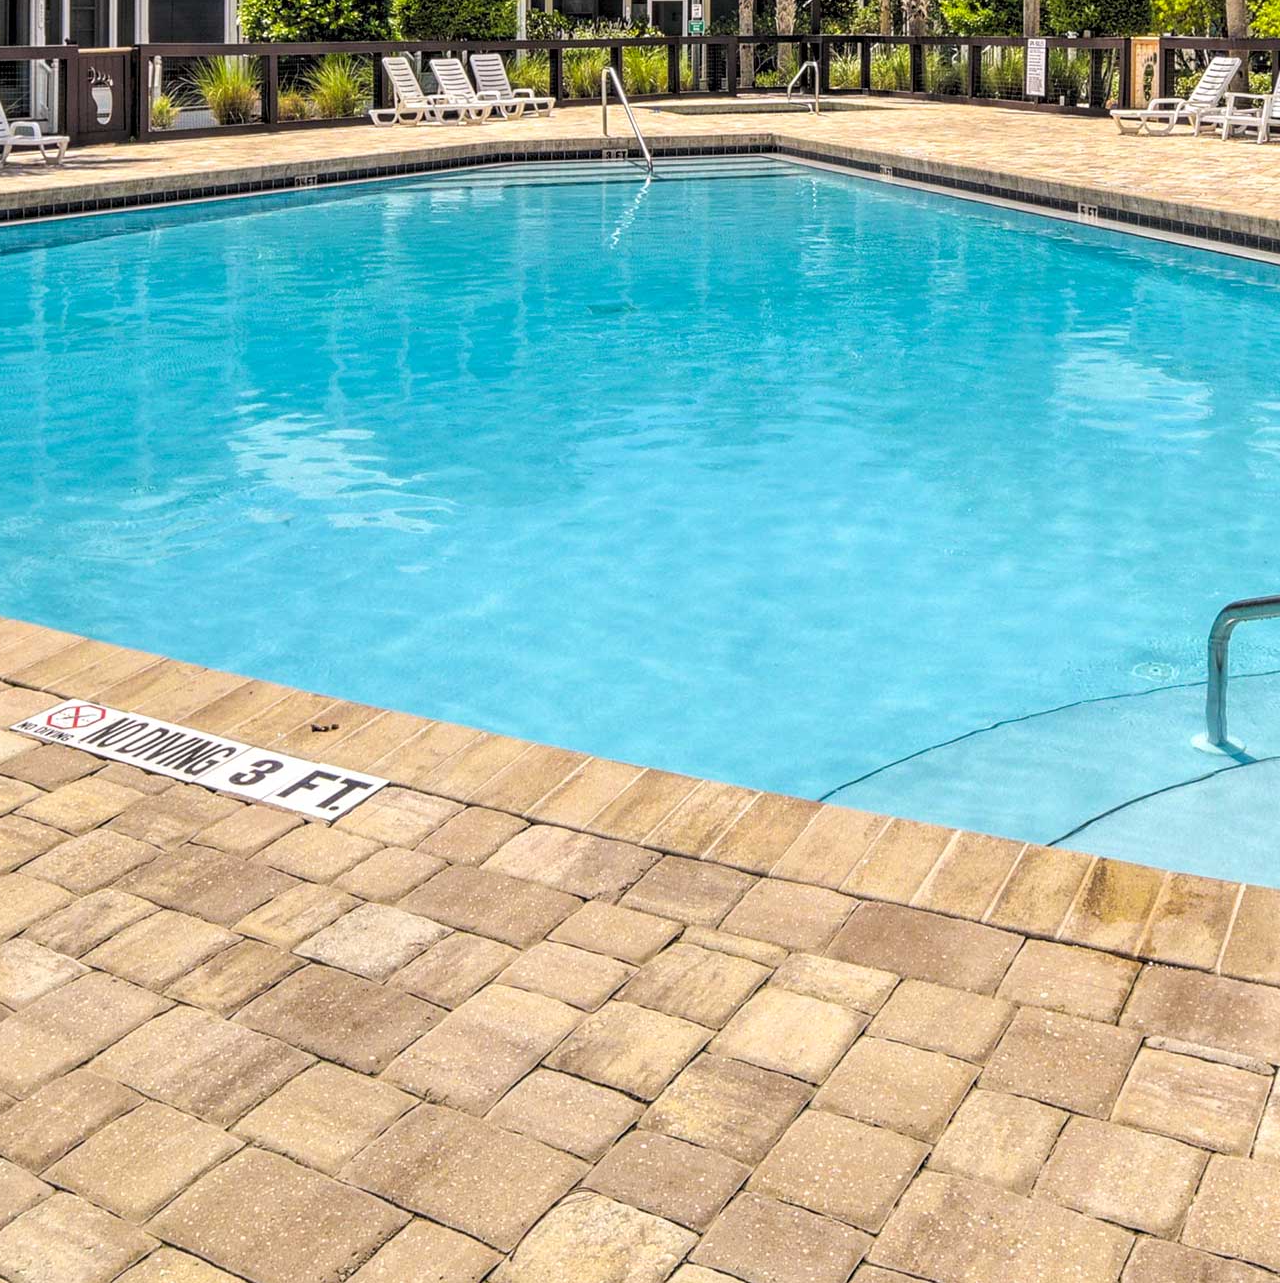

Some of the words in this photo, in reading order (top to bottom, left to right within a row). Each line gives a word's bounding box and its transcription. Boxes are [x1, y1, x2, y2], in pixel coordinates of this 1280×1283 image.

[18, 721, 37, 731] NO
[34, 725, 74, 741] DIVING
[80, 717, 149, 748] NO
[114, 727, 237, 777] DIVING
[228, 759, 284, 786] 3
[276, 769, 375, 811] FT.
